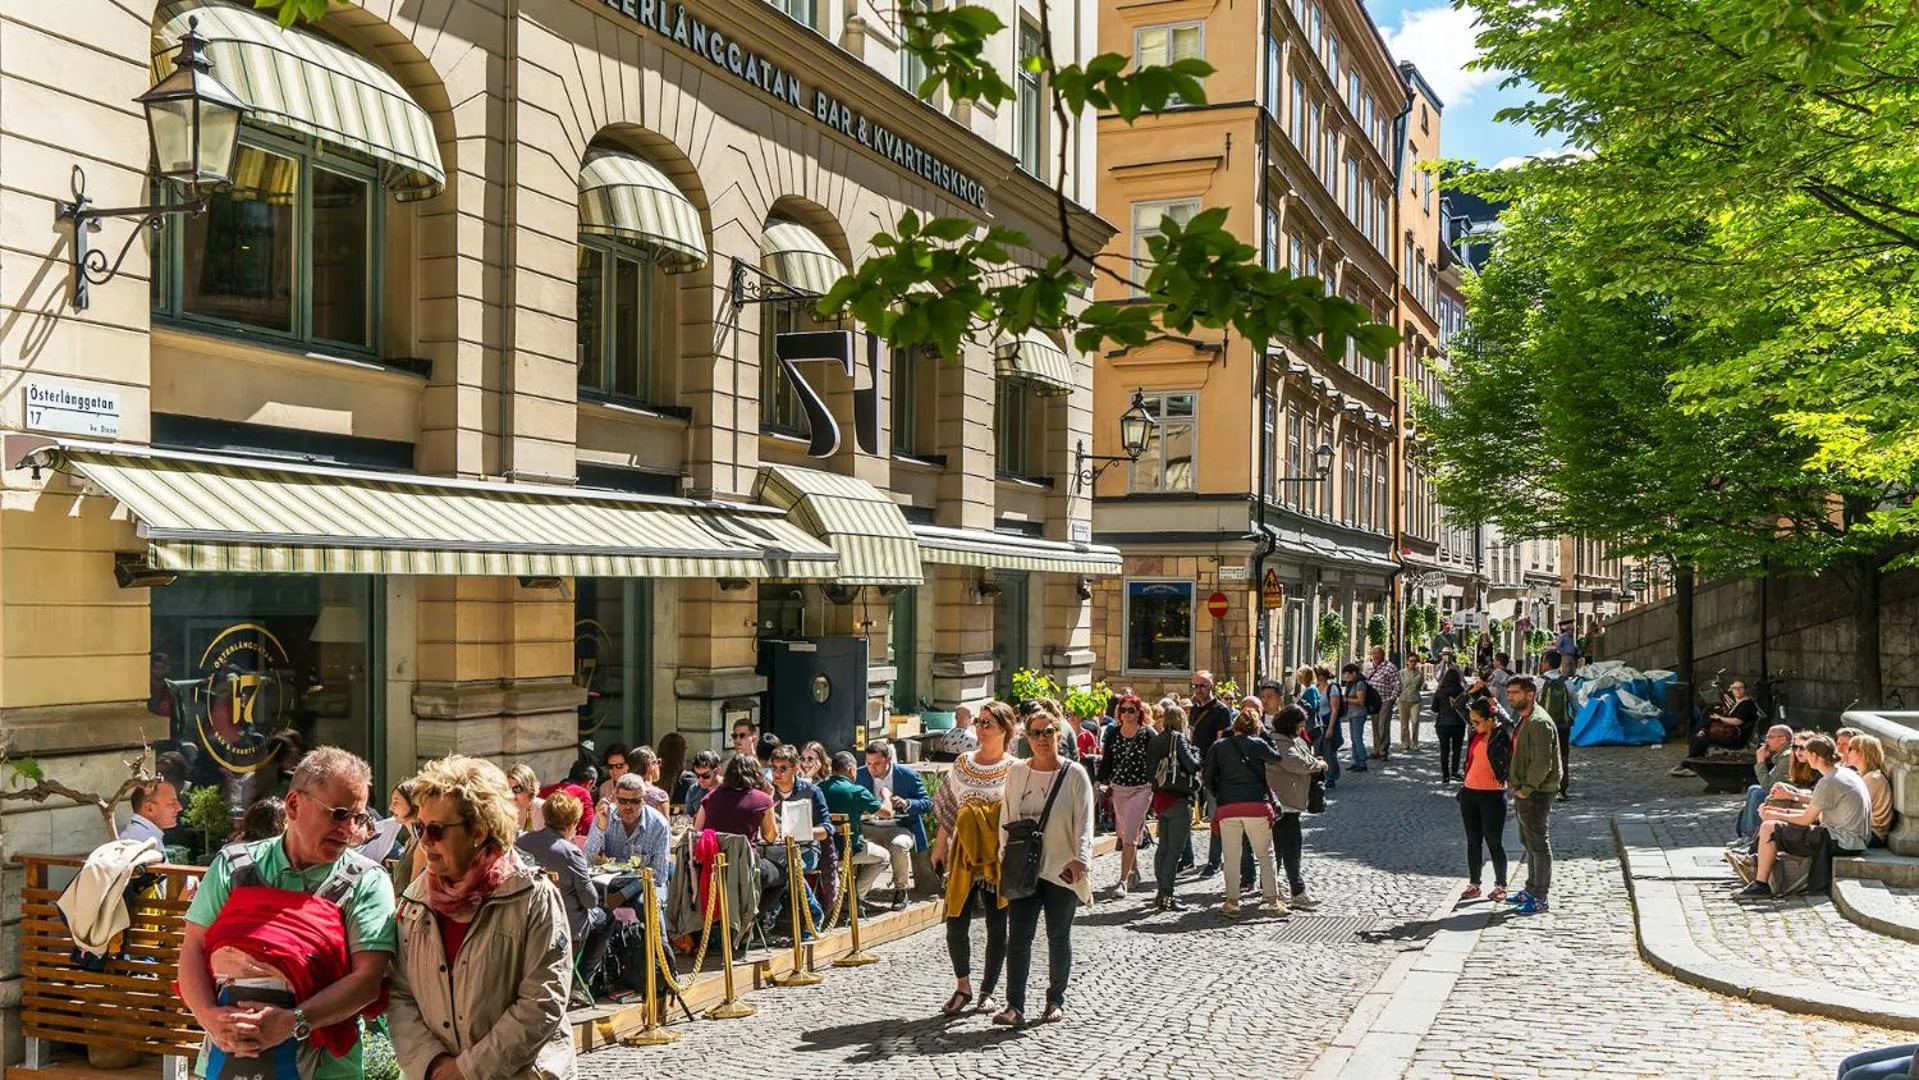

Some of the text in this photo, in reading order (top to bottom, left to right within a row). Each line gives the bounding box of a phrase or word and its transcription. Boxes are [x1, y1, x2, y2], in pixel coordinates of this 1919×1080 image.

[606, 0, 987, 209] ERLÅNGGATAN BAR & KVARTERSKROG
[30, 383, 114, 410] Österlånggatan
[30, 410, 42, 425] 17
[230, 674, 264, 725] 17
